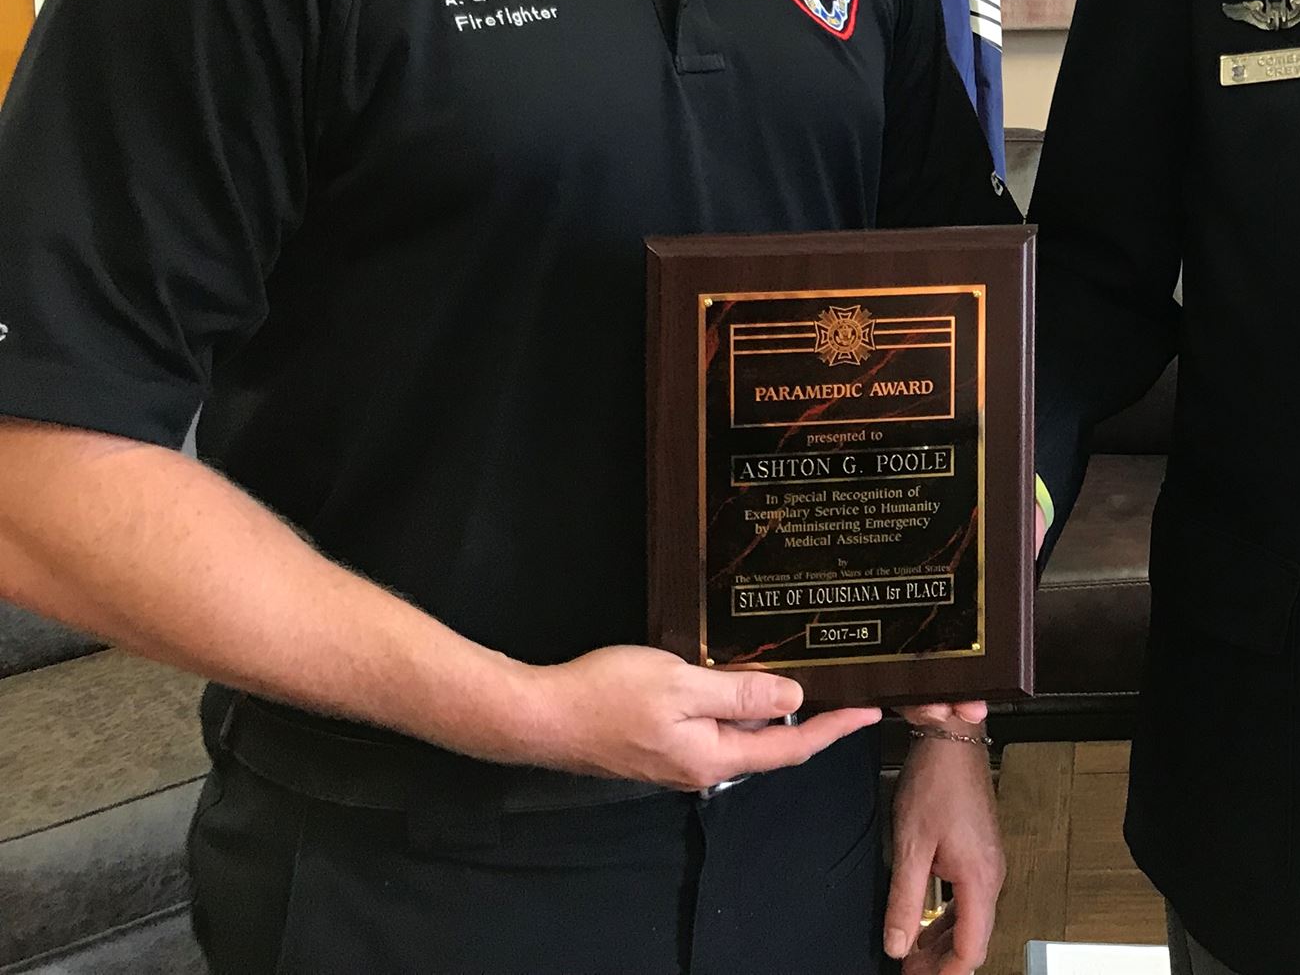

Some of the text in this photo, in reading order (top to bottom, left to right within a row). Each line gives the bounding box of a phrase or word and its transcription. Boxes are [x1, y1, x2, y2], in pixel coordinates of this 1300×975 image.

[455, 6, 558, 31] Firefighter
[755, 380, 934, 402] PARAMEDIC AWARD
[807, 430, 883, 446] presented to
[739, 452, 947, 479] ASHTON G. POOLE
[766, 485, 921, 507] In Special Recognition of
[744, 500, 941, 522] Exemplary Service to Humanity
[755, 515, 931, 537] by Administering Emergency
[784, 532, 902, 548] Medical Assistance
[735, 564, 950, 583] The Veterans of Foreign Wars of the United States
[838, 558, 848, 568] by
[739, 591, 781, 608] STATE
[786, 590, 804, 605] OF
[809, 586, 880, 605] LOUISIANA
[906, 581, 947, 598] PLACE
[820, 627, 869, 641] 2017-18
